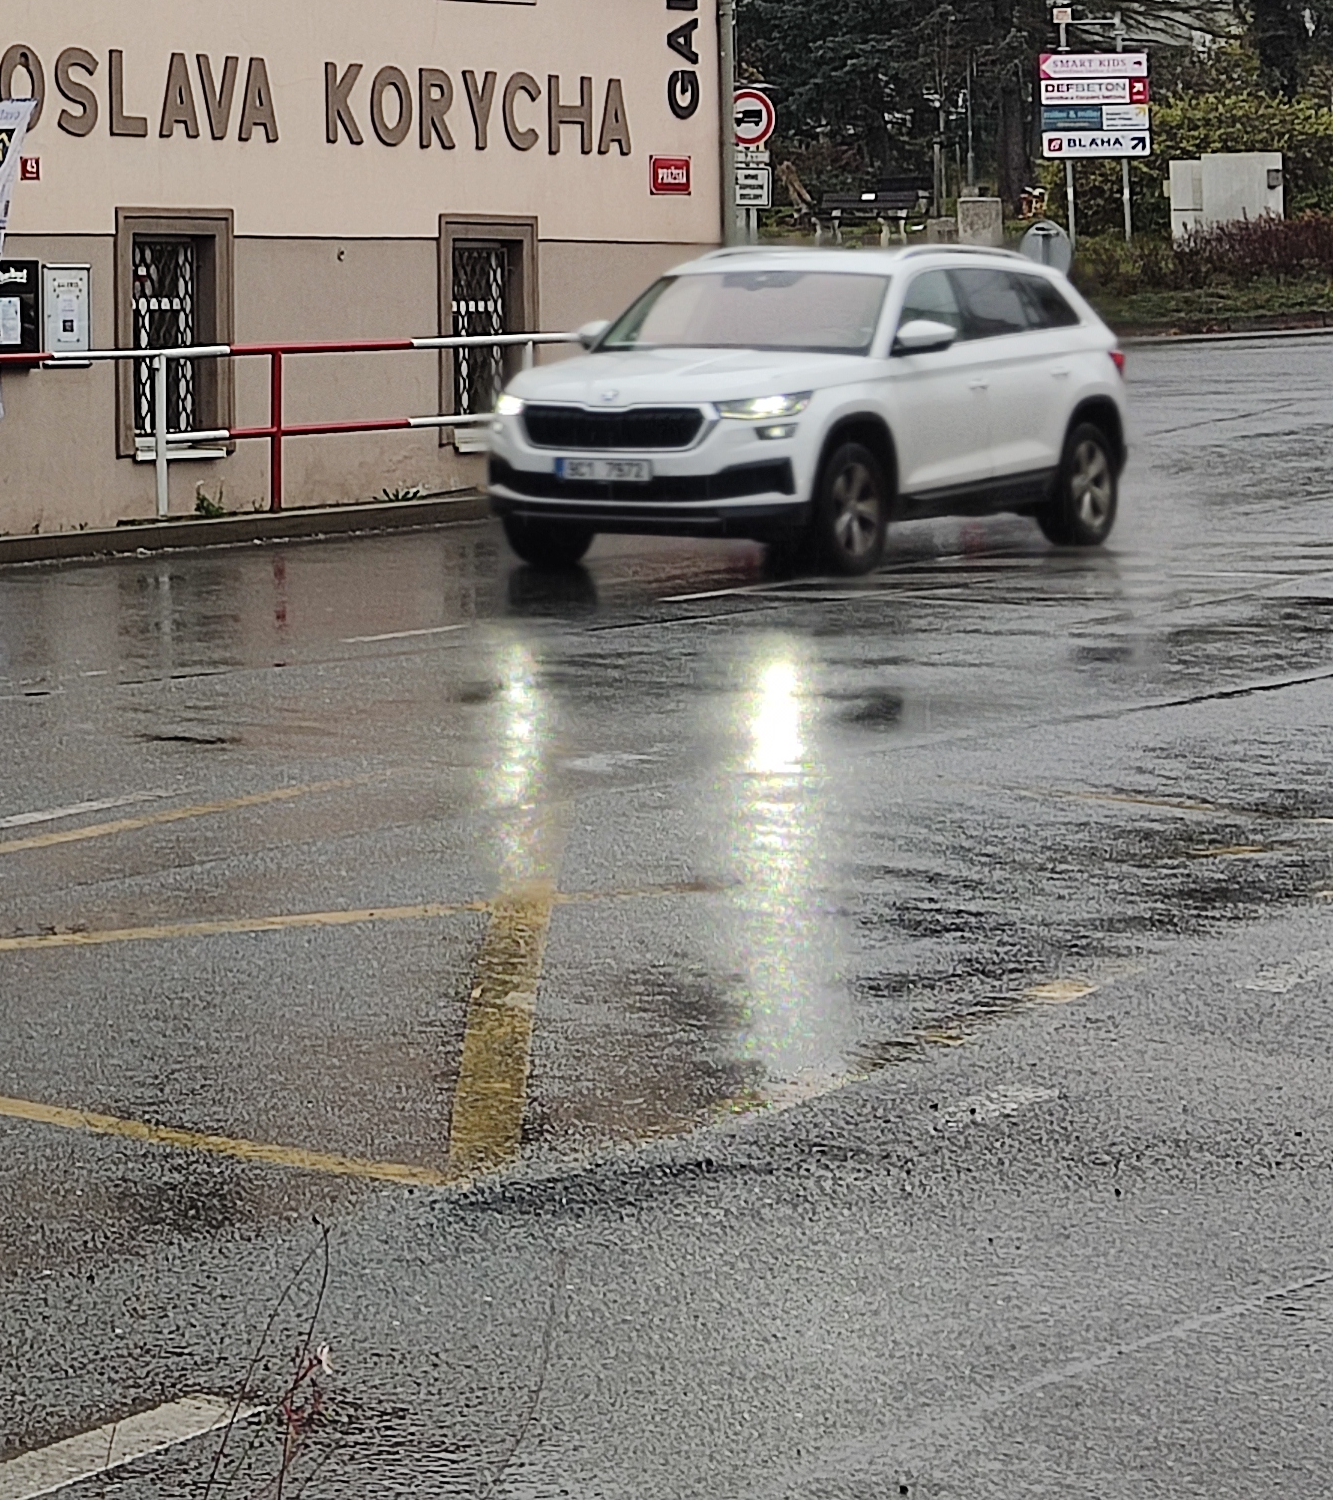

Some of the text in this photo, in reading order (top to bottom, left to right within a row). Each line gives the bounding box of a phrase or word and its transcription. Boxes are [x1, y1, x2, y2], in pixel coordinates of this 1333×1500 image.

[1052, 60, 1093, 69] SMART
[1044, 82, 1126, 93] DEFBETON
[324, 60, 633, 157] KORYCHA
